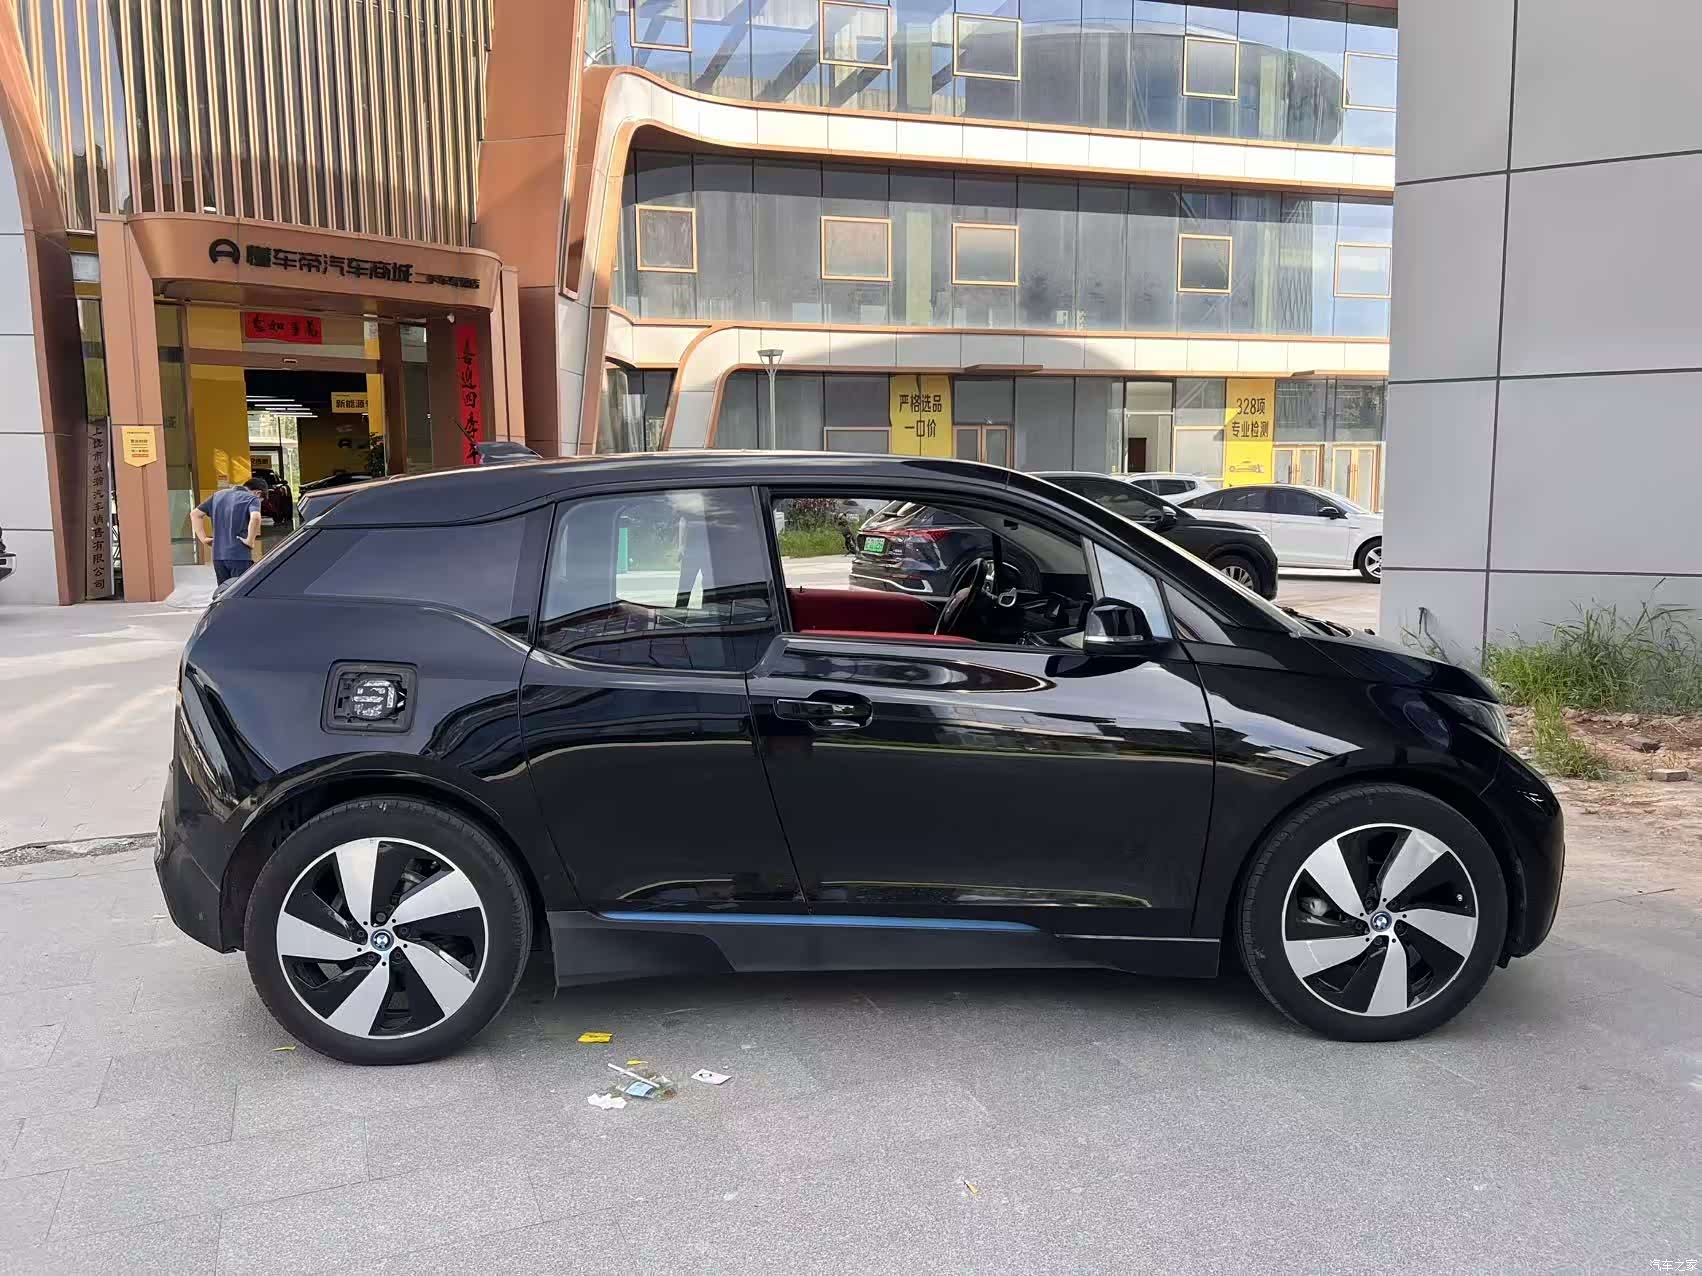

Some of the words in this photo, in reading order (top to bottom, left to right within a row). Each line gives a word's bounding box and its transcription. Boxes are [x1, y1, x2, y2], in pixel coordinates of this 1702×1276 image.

[899, 394, 942, 413] 严格选品
[1236, 398, 1266, 415] 328项
[904, 418, 936, 438] 一口价
[1232, 421, 1269, 437] 专业检测
